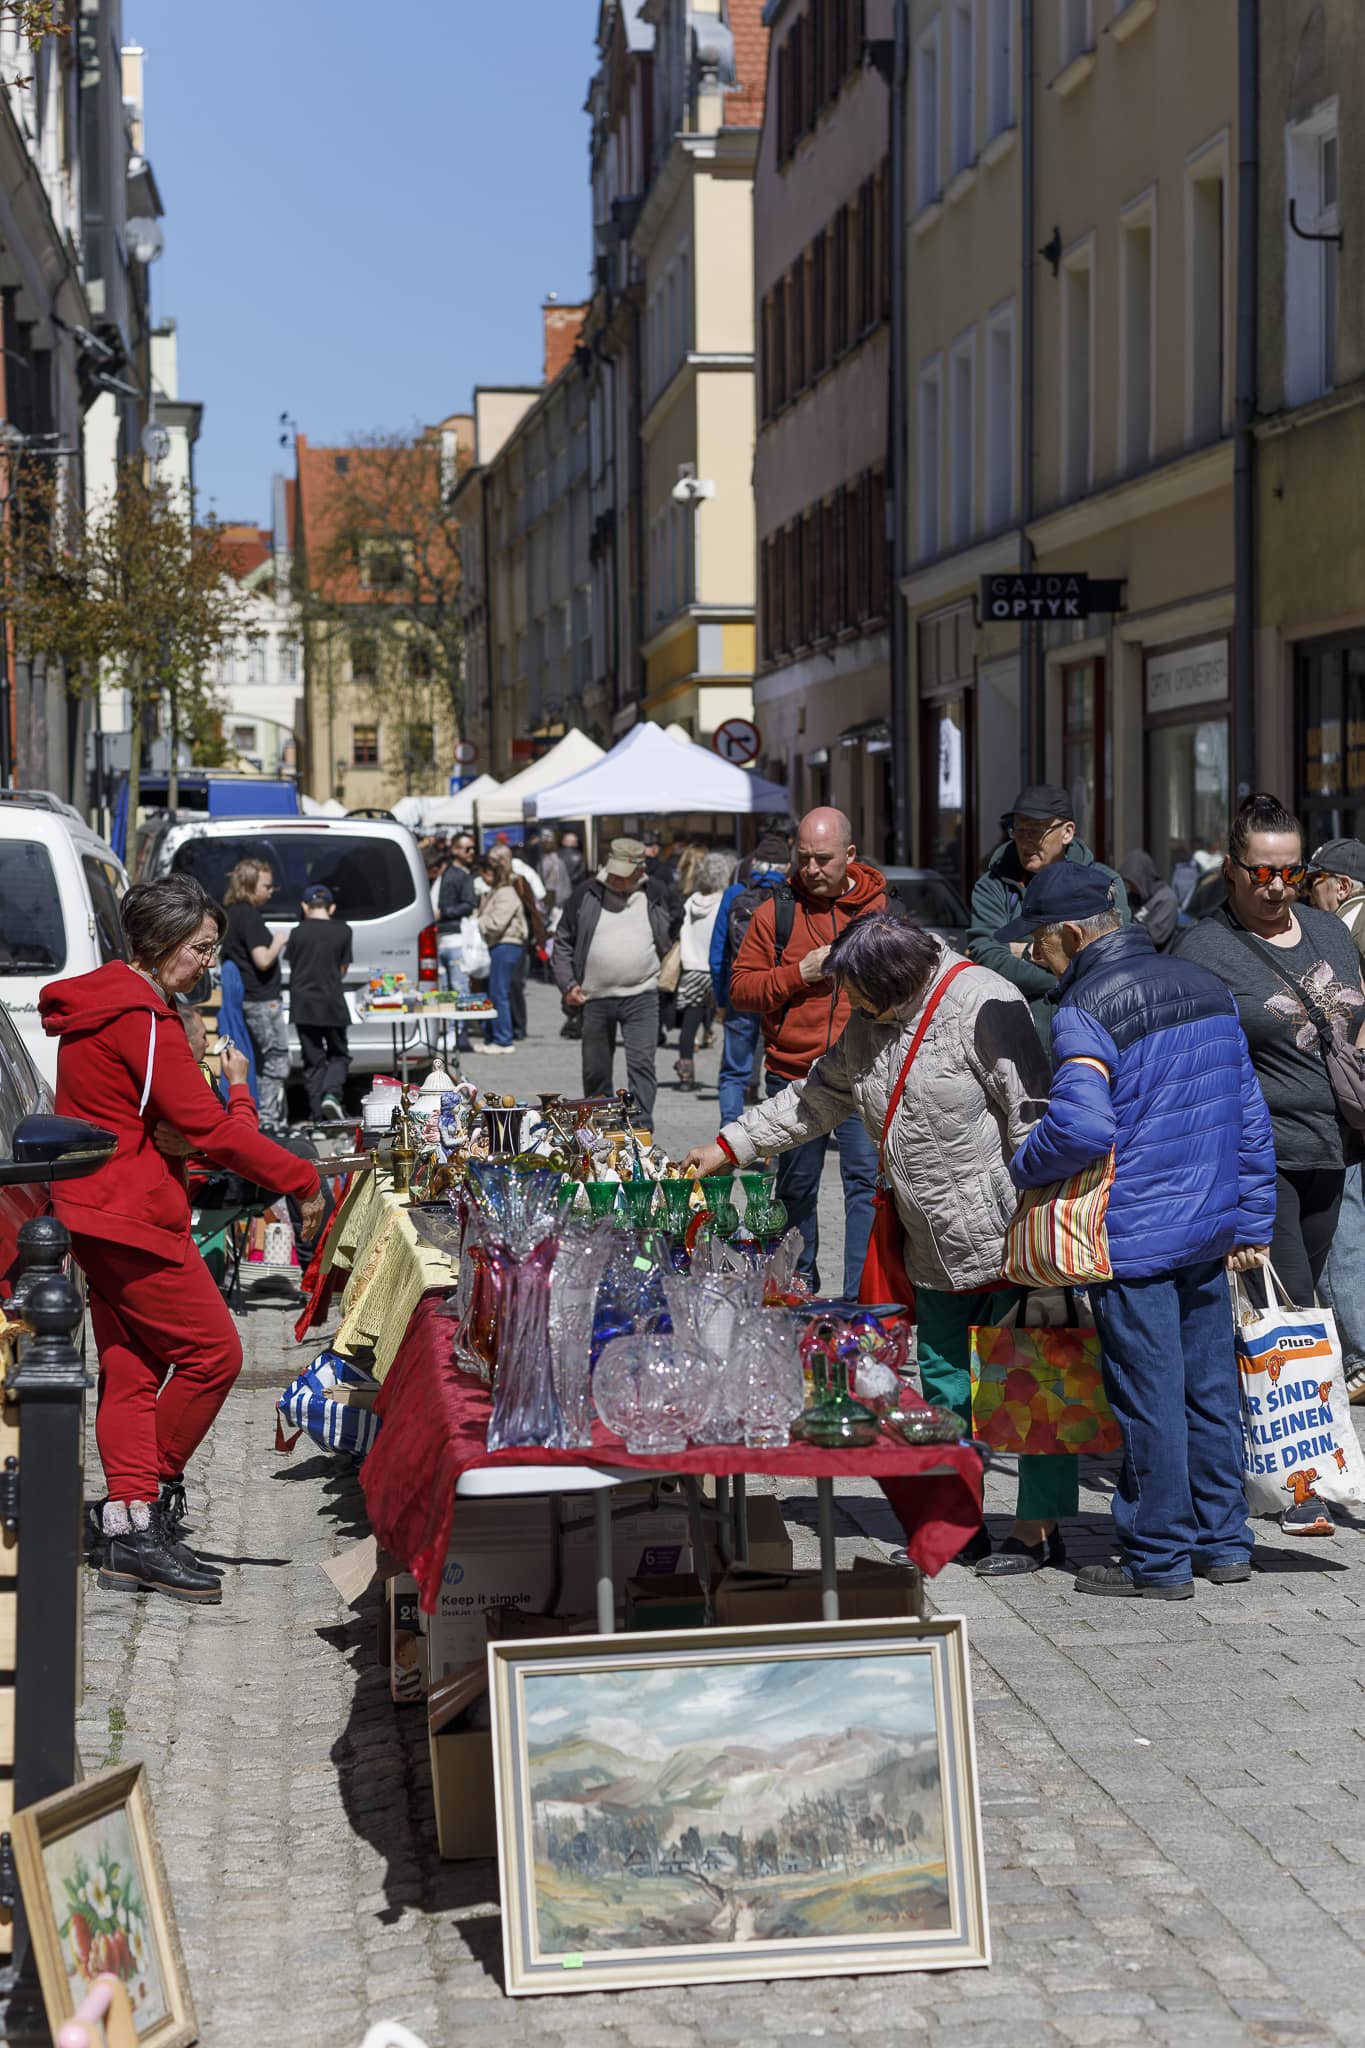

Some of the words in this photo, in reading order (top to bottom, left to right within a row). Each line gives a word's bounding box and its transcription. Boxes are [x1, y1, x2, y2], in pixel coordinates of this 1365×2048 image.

[991, 577, 1080, 596] GAJDA
[991, 598, 1080, 617] OPTYK
[1266, 1379, 1319, 1412] SIND
[1251, 1405, 1334, 1446] KLEINEN
[1280, 1431, 1339, 1469] DRIN.
[645, 1551, 656, 1566] 6
[444, 1562, 465, 1585] hp
[441, 1595, 474, 1607] Keep
[478, 1593, 486, 1605] it
[490, 1592, 531, 1606] simple
[441, 1609, 472, 1618] DeskJet
